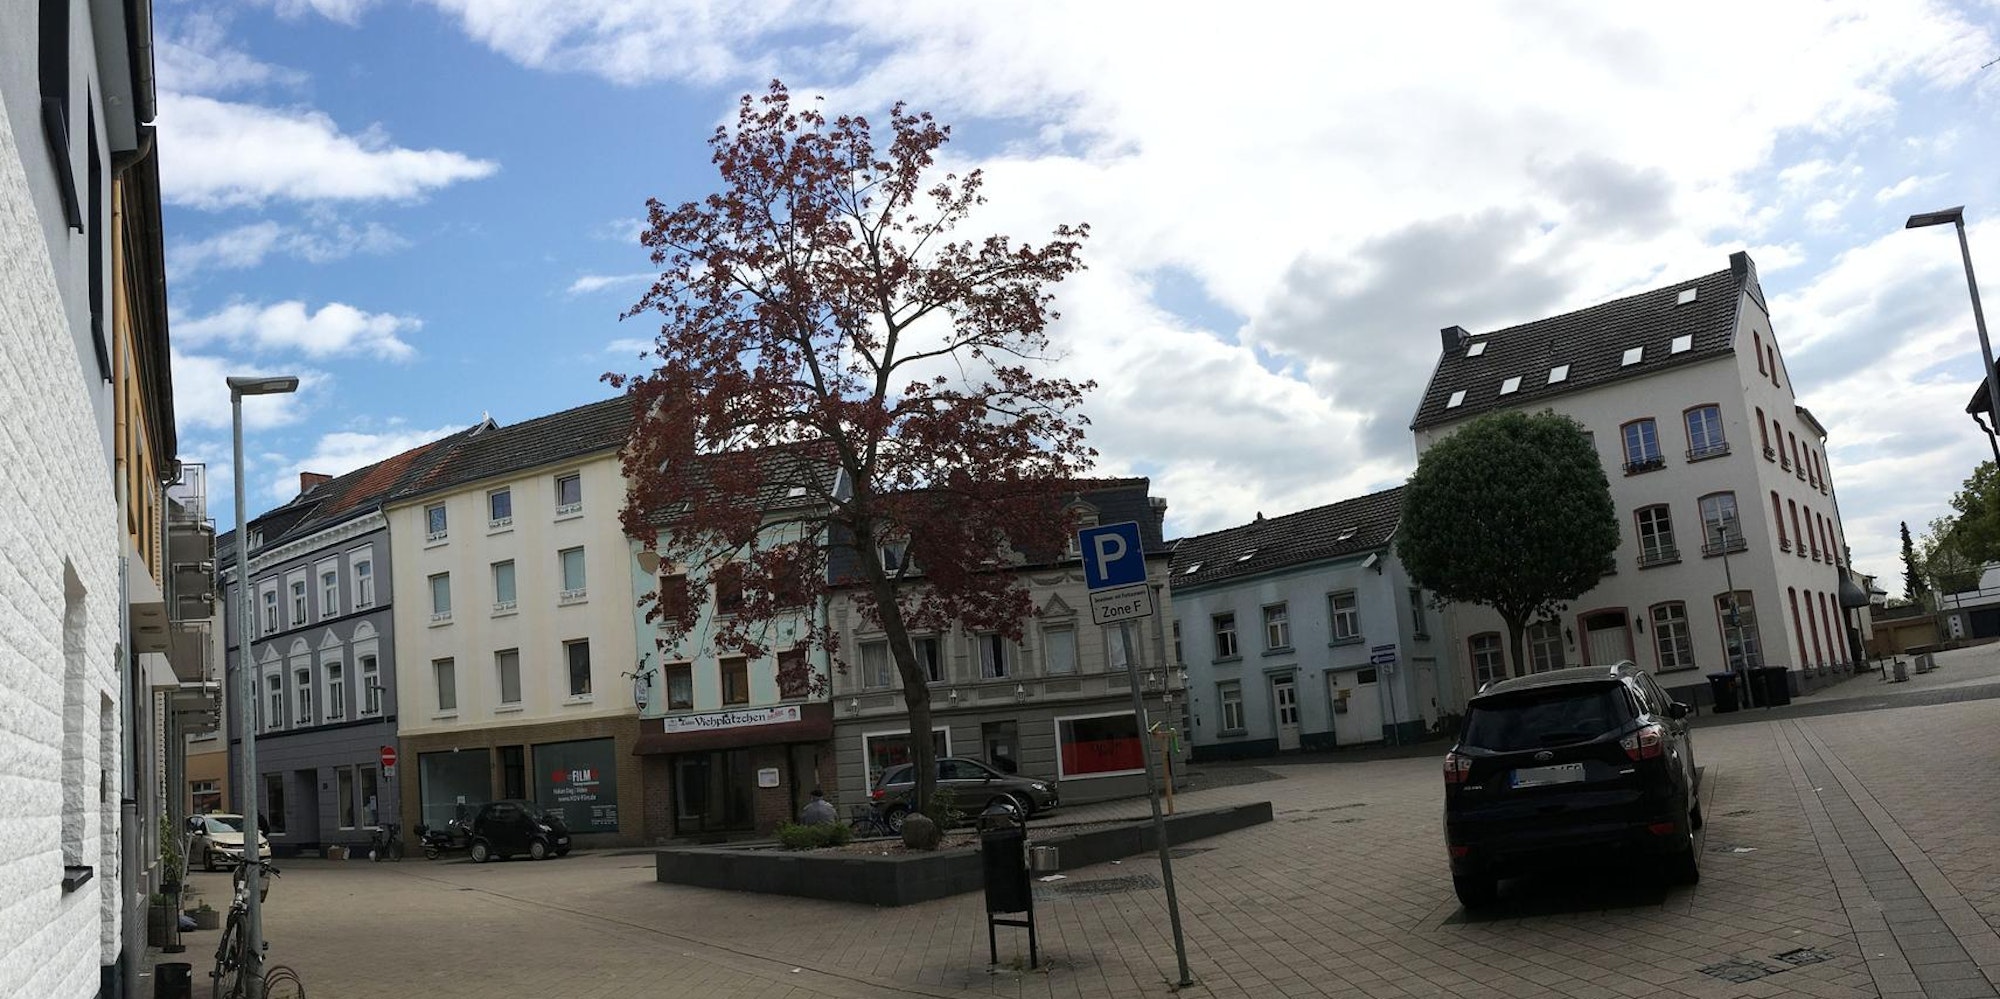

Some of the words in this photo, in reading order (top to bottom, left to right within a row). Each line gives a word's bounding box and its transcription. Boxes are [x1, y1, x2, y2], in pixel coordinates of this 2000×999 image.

[1094, 533, 1127, 580] P
[1101, 605, 1131, 618] Zone
[1133, 600, 1142, 612] F
